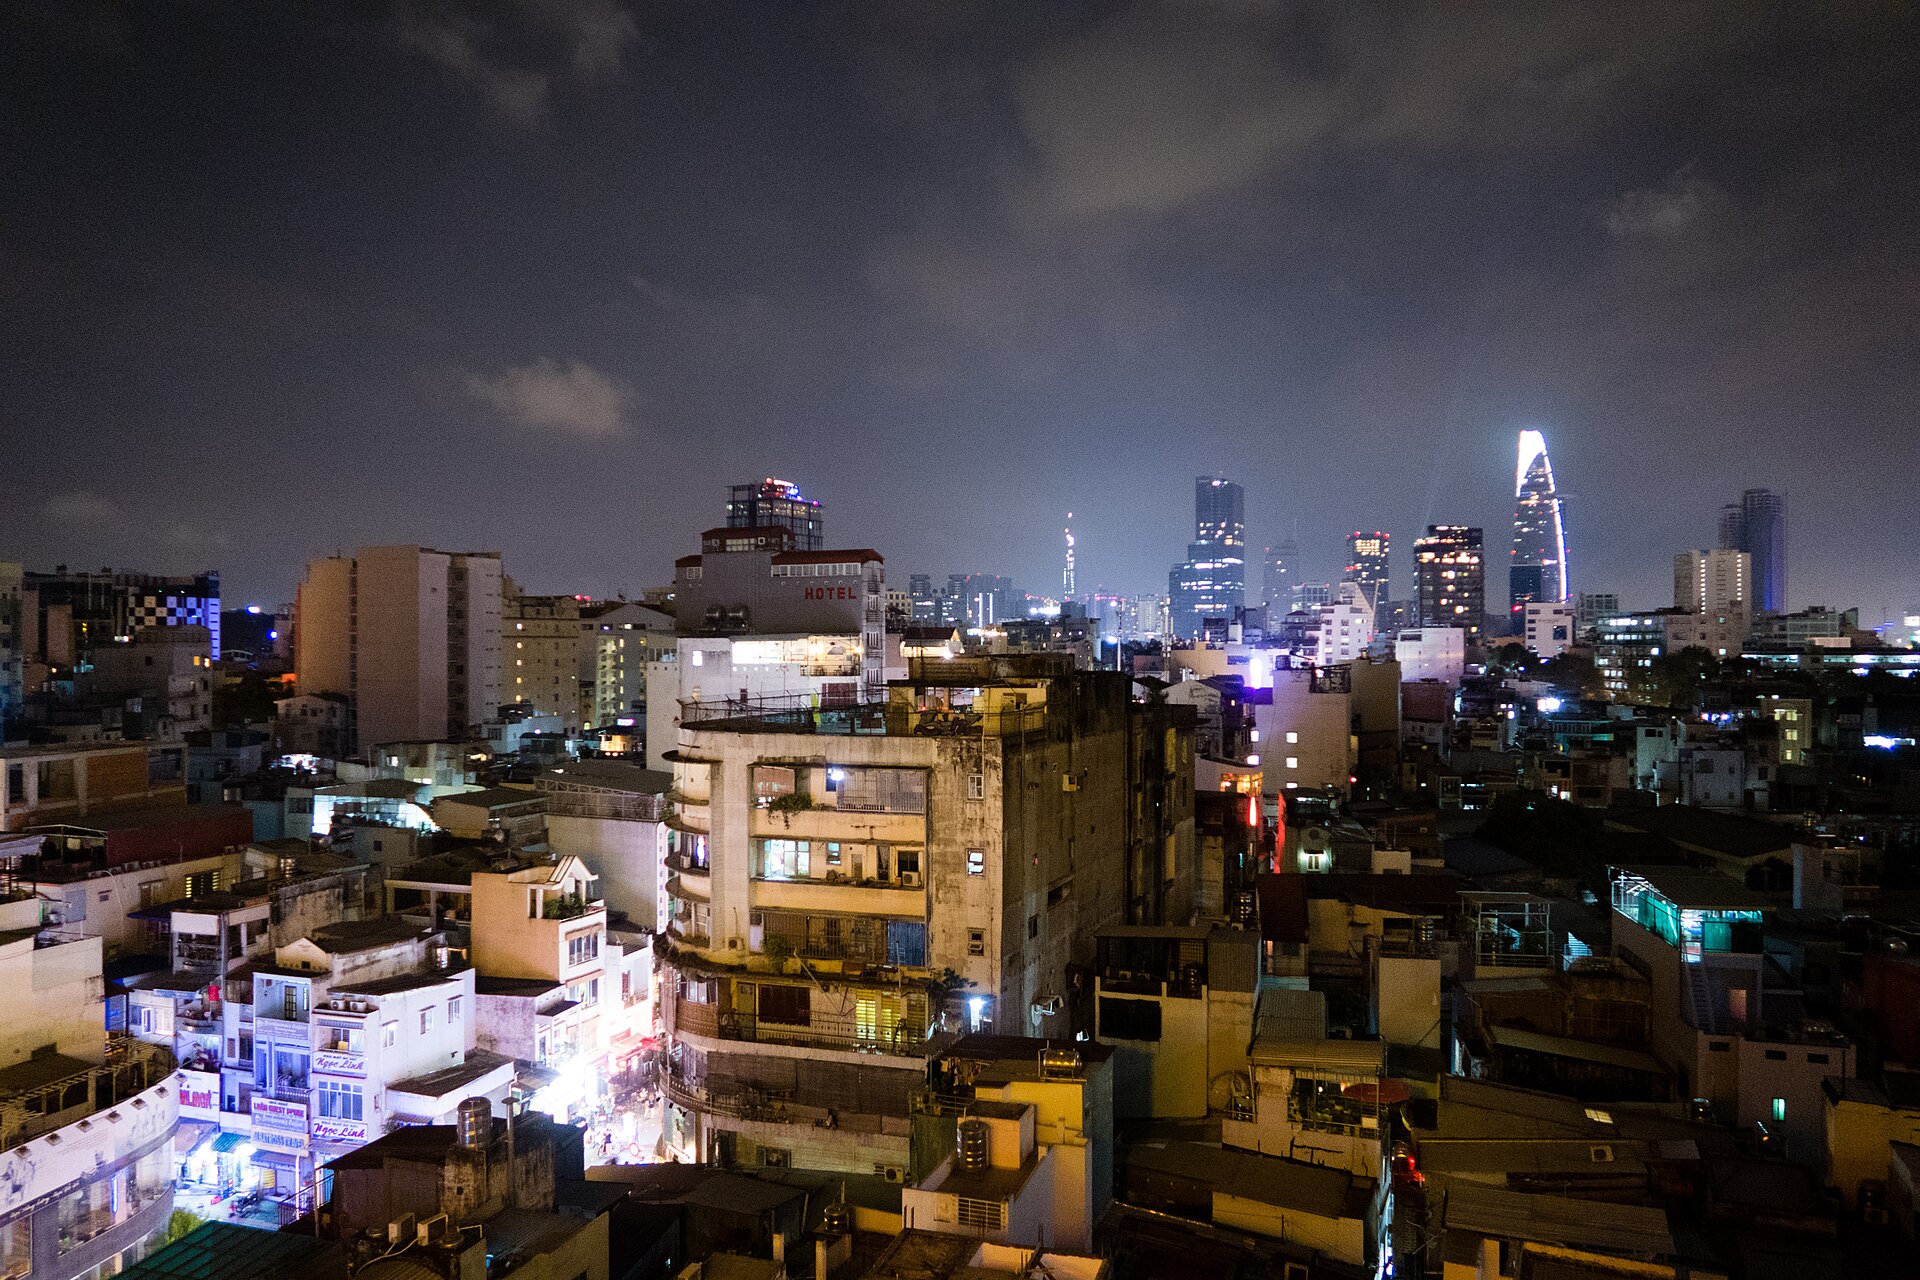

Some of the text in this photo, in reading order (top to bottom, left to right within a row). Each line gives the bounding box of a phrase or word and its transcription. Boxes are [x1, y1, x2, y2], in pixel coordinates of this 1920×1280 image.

[804, 586, 857, 600] HOTEL
[339, 1059, 364, 1070] Linh
[338, 1126, 365, 1138] Linh
